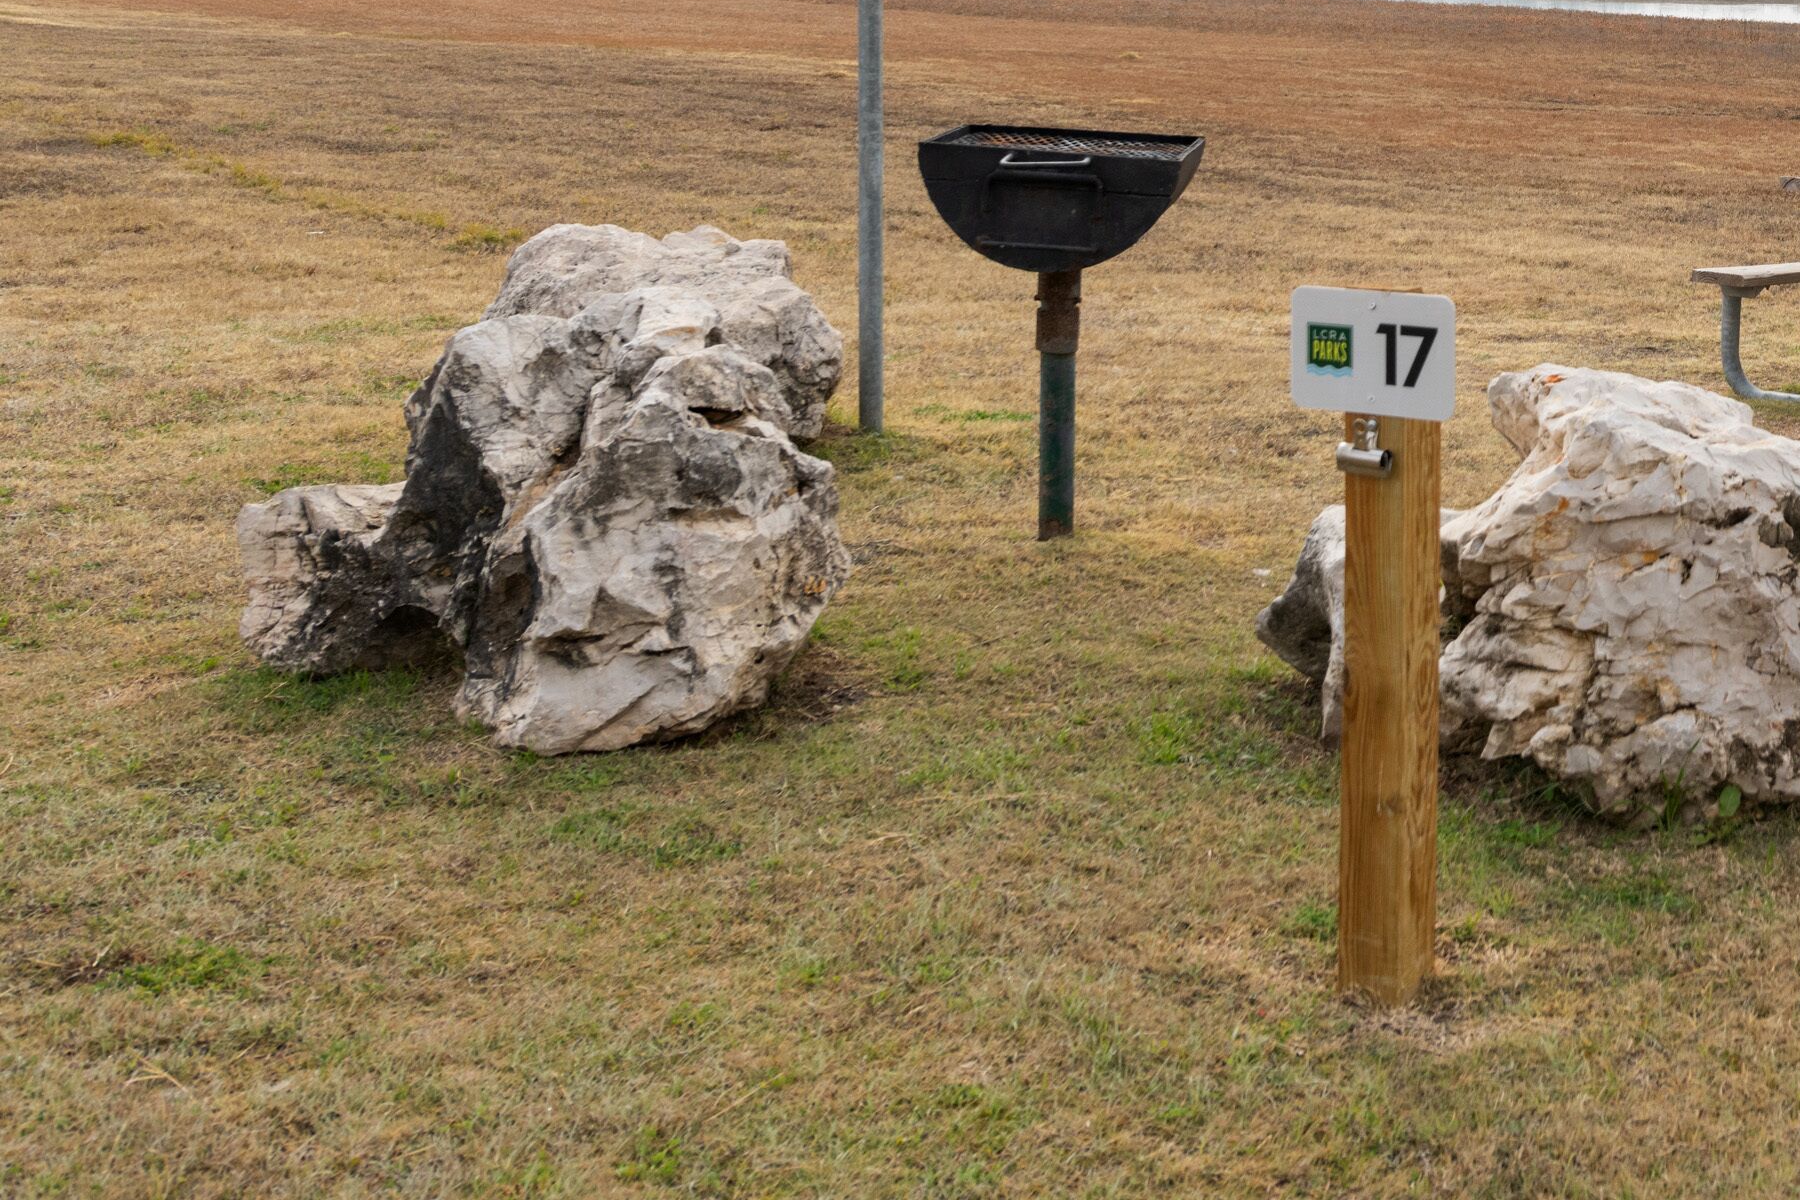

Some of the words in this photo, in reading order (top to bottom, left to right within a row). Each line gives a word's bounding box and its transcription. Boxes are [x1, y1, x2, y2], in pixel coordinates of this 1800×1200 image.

[1313, 329, 1347, 340] LCRA
[1312, 340, 1348, 363] PARKS
[1375, 323, 1438, 387] 17
